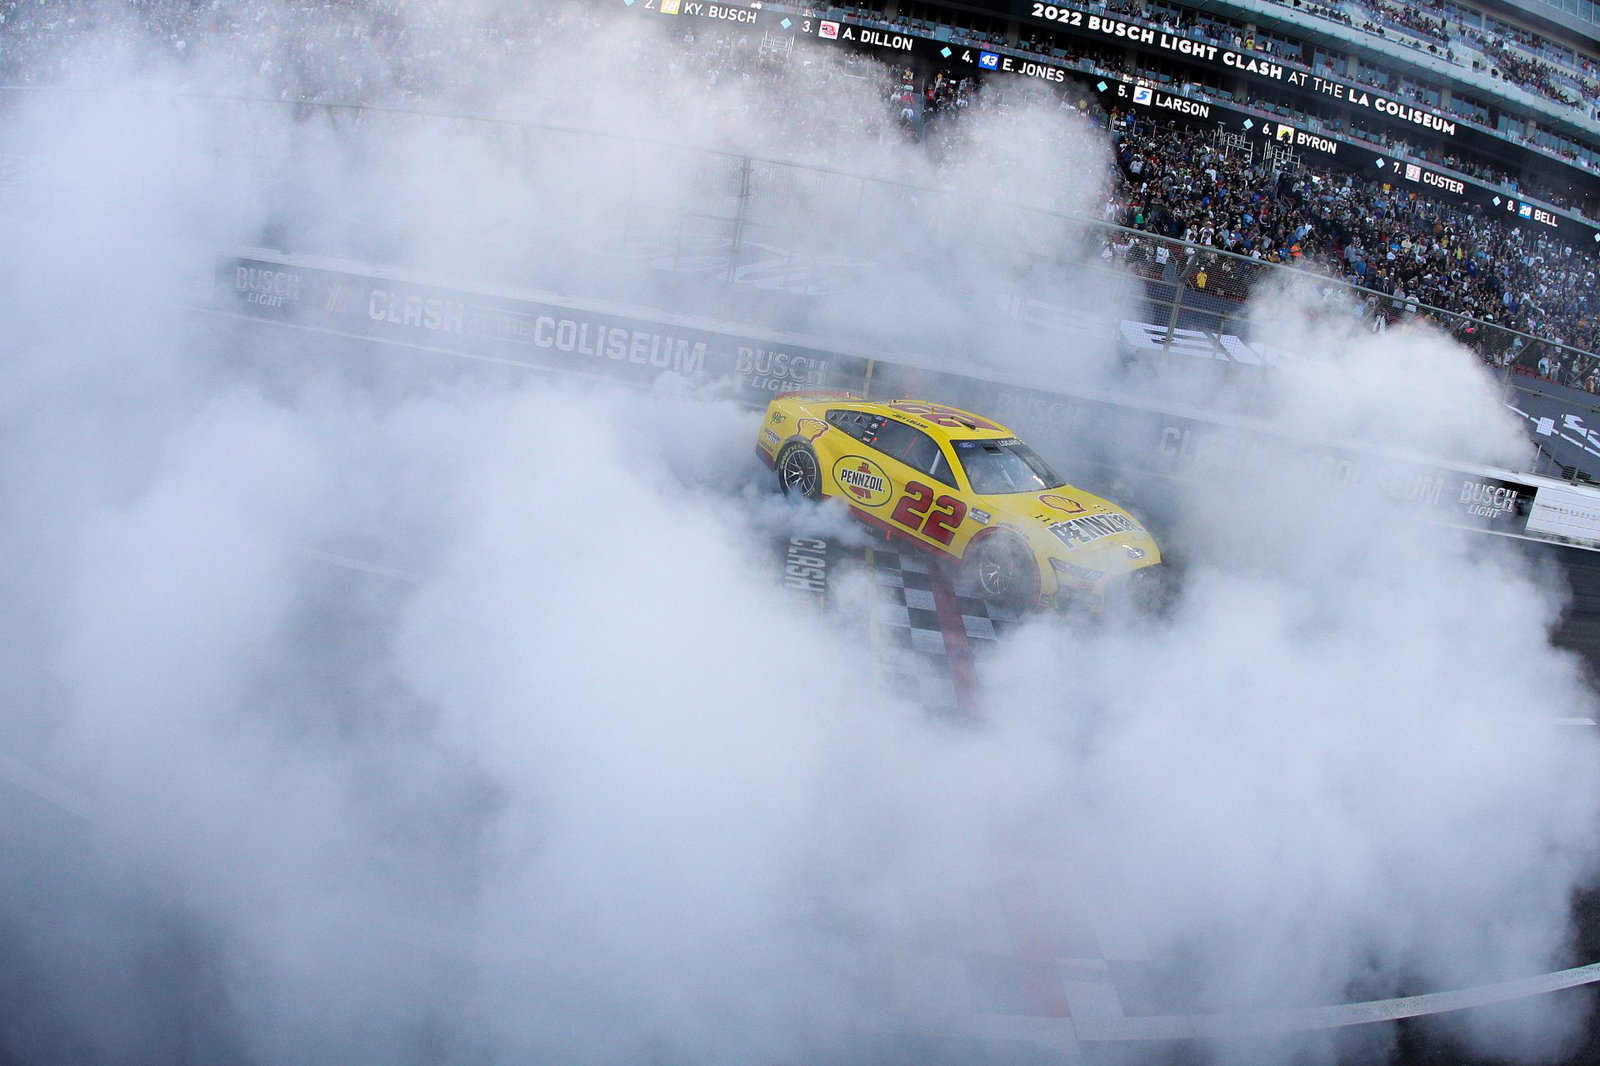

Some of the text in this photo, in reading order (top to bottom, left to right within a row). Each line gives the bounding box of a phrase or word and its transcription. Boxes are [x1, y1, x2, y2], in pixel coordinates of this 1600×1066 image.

[644, 0, 655, 10] 2.
[684, 2, 704, 16] KY.
[709, 6, 757, 24] BUSCH
[802, 21, 813, 33] 3.
[842, 28, 856, 41] A.
[860, 30, 913, 51] DILLON
[962, 50, 1065, 82] 4. 43 E. JONES
[1031, 3, 1456, 136] 2022 BUSCH LIGHT CLASH AT THE LA COLISEUM
[1117, 85, 1128, 98] 5.
[1155, 94, 1210, 118] LARSON
[1262, 123, 1272, 136] 6.
[1297, 132, 1337, 155] BYRON
[1393, 161, 1402, 175] 7.
[1423, 172, 1464, 195] CUSTER
[1507, 200, 1516, 212] 8.
[1534, 209, 1558, 228] BELL
[236, 265, 300, 300] BUSCH
[247, 292, 283, 307] LIGHT
[368, 290, 464, 333] CLASH
[534, 316, 708, 374] COLISEUM
[736, 346, 828, 388] BUSCH
[840, 468, 884, 492] PENNZOIL
[1458, 480, 1518, 513] BUSCH
[890, 480, 967, 546] 22
[1468, 504, 1502, 518] LIGHT
[784, 536, 827, 592] CLASH
